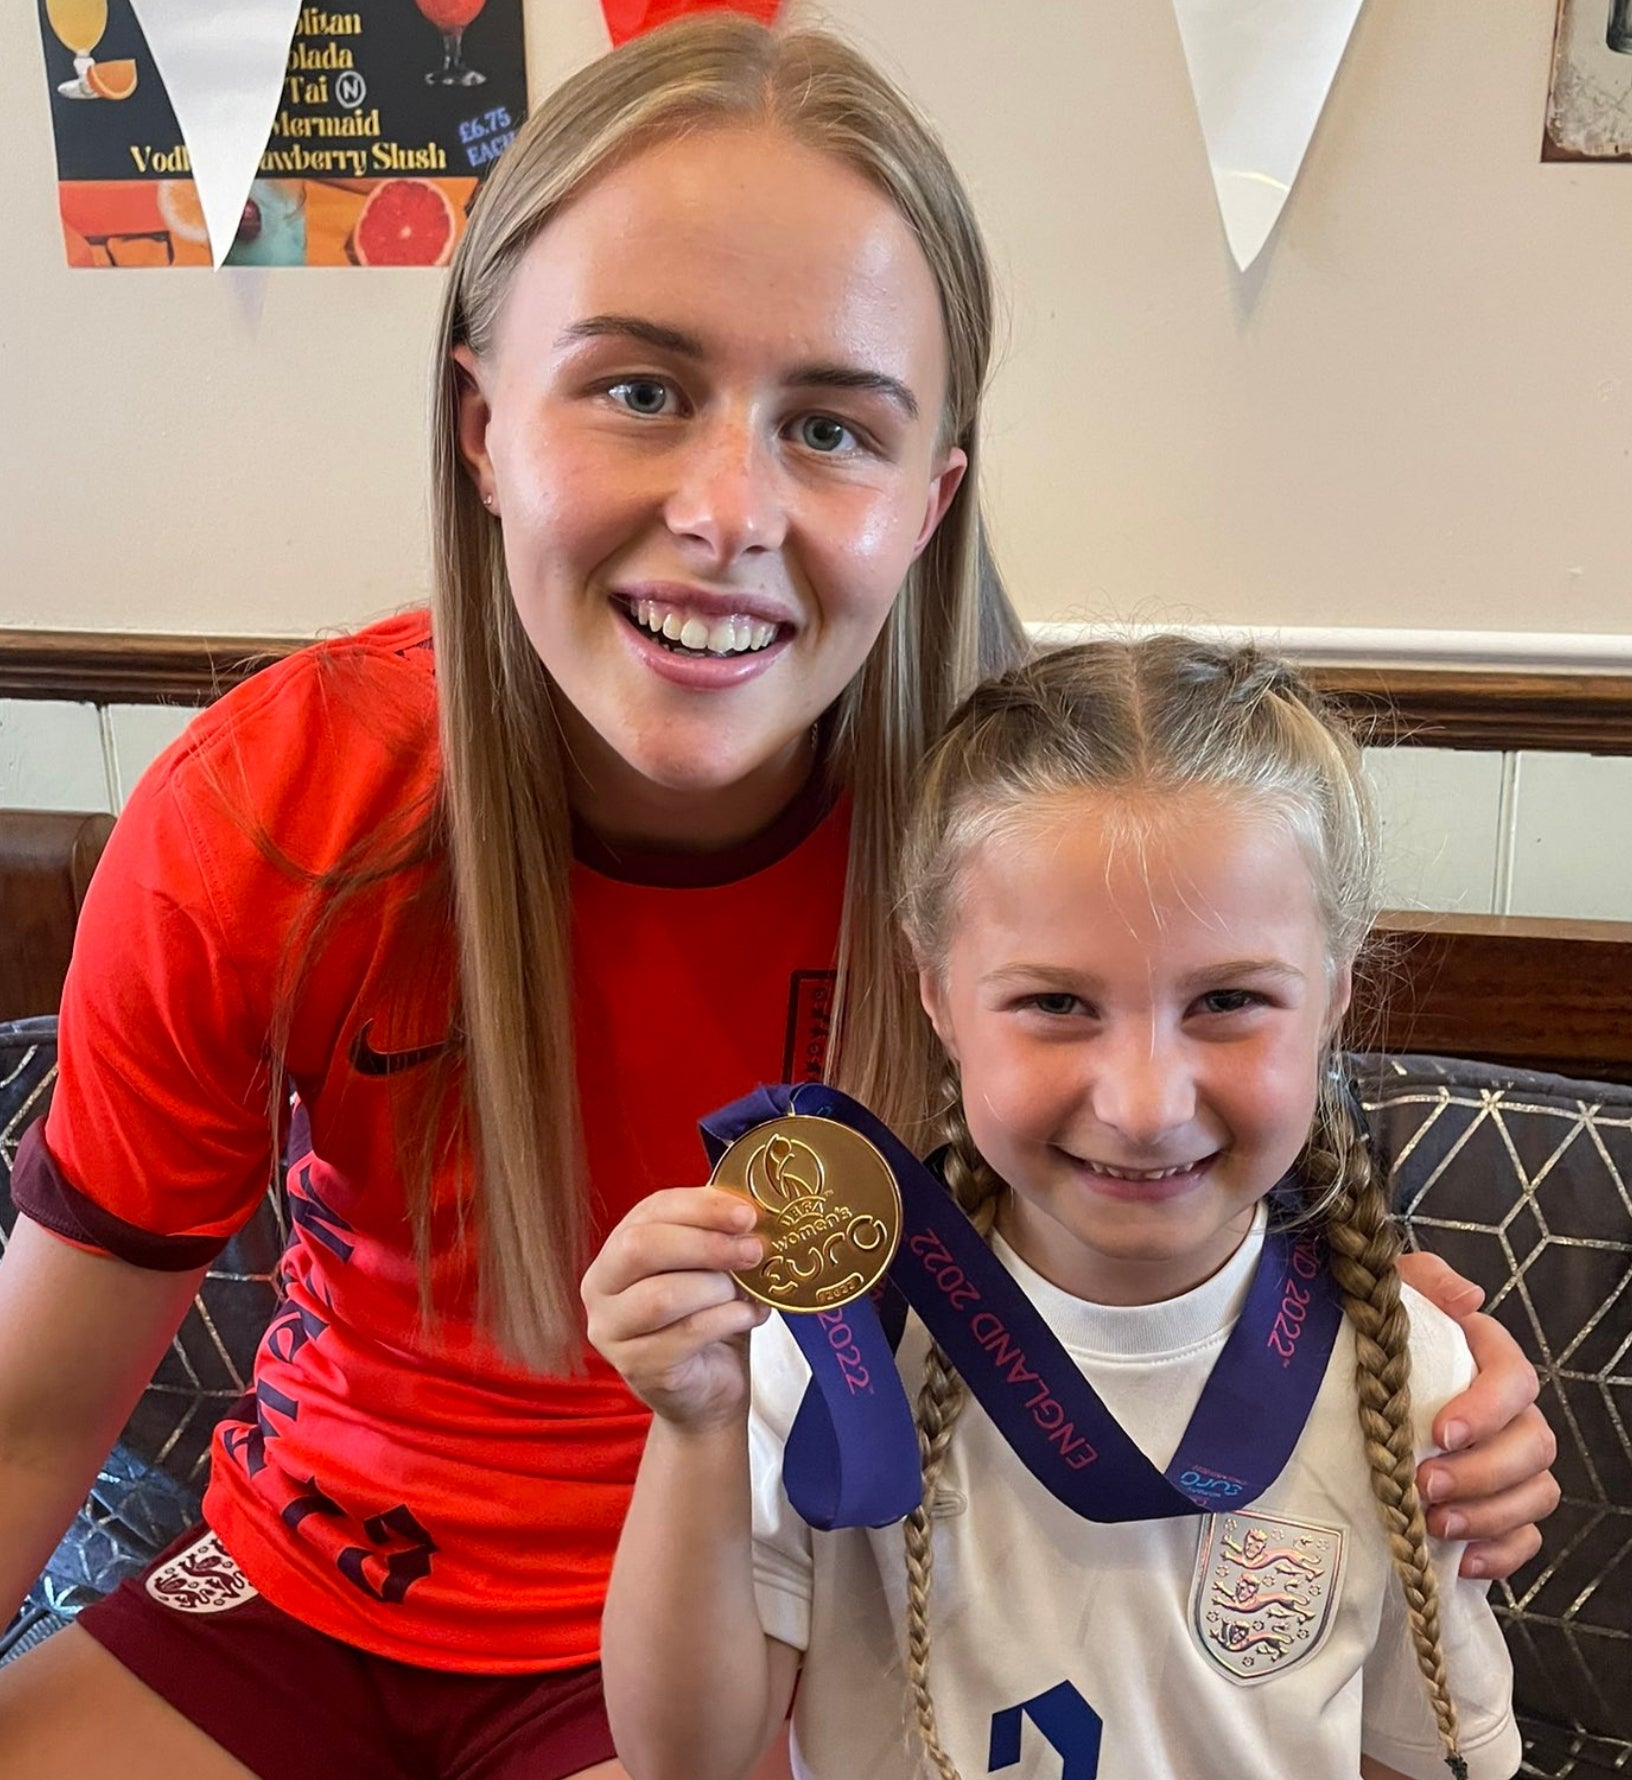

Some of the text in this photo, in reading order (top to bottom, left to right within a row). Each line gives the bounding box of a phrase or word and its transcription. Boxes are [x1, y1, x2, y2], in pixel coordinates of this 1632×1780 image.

[288, 42, 353, 70] olada
[285, 75, 328, 104] Tai
[458, 106, 511, 144] £6.75
[259, 143, 367, 177] awberry
[371, 141, 446, 171] Slush
[1267, 1278, 1311, 1358] 2022
[815, 1307, 870, 1396] 2022
[909, 1227, 1099, 1470] ENGLAND 2022
